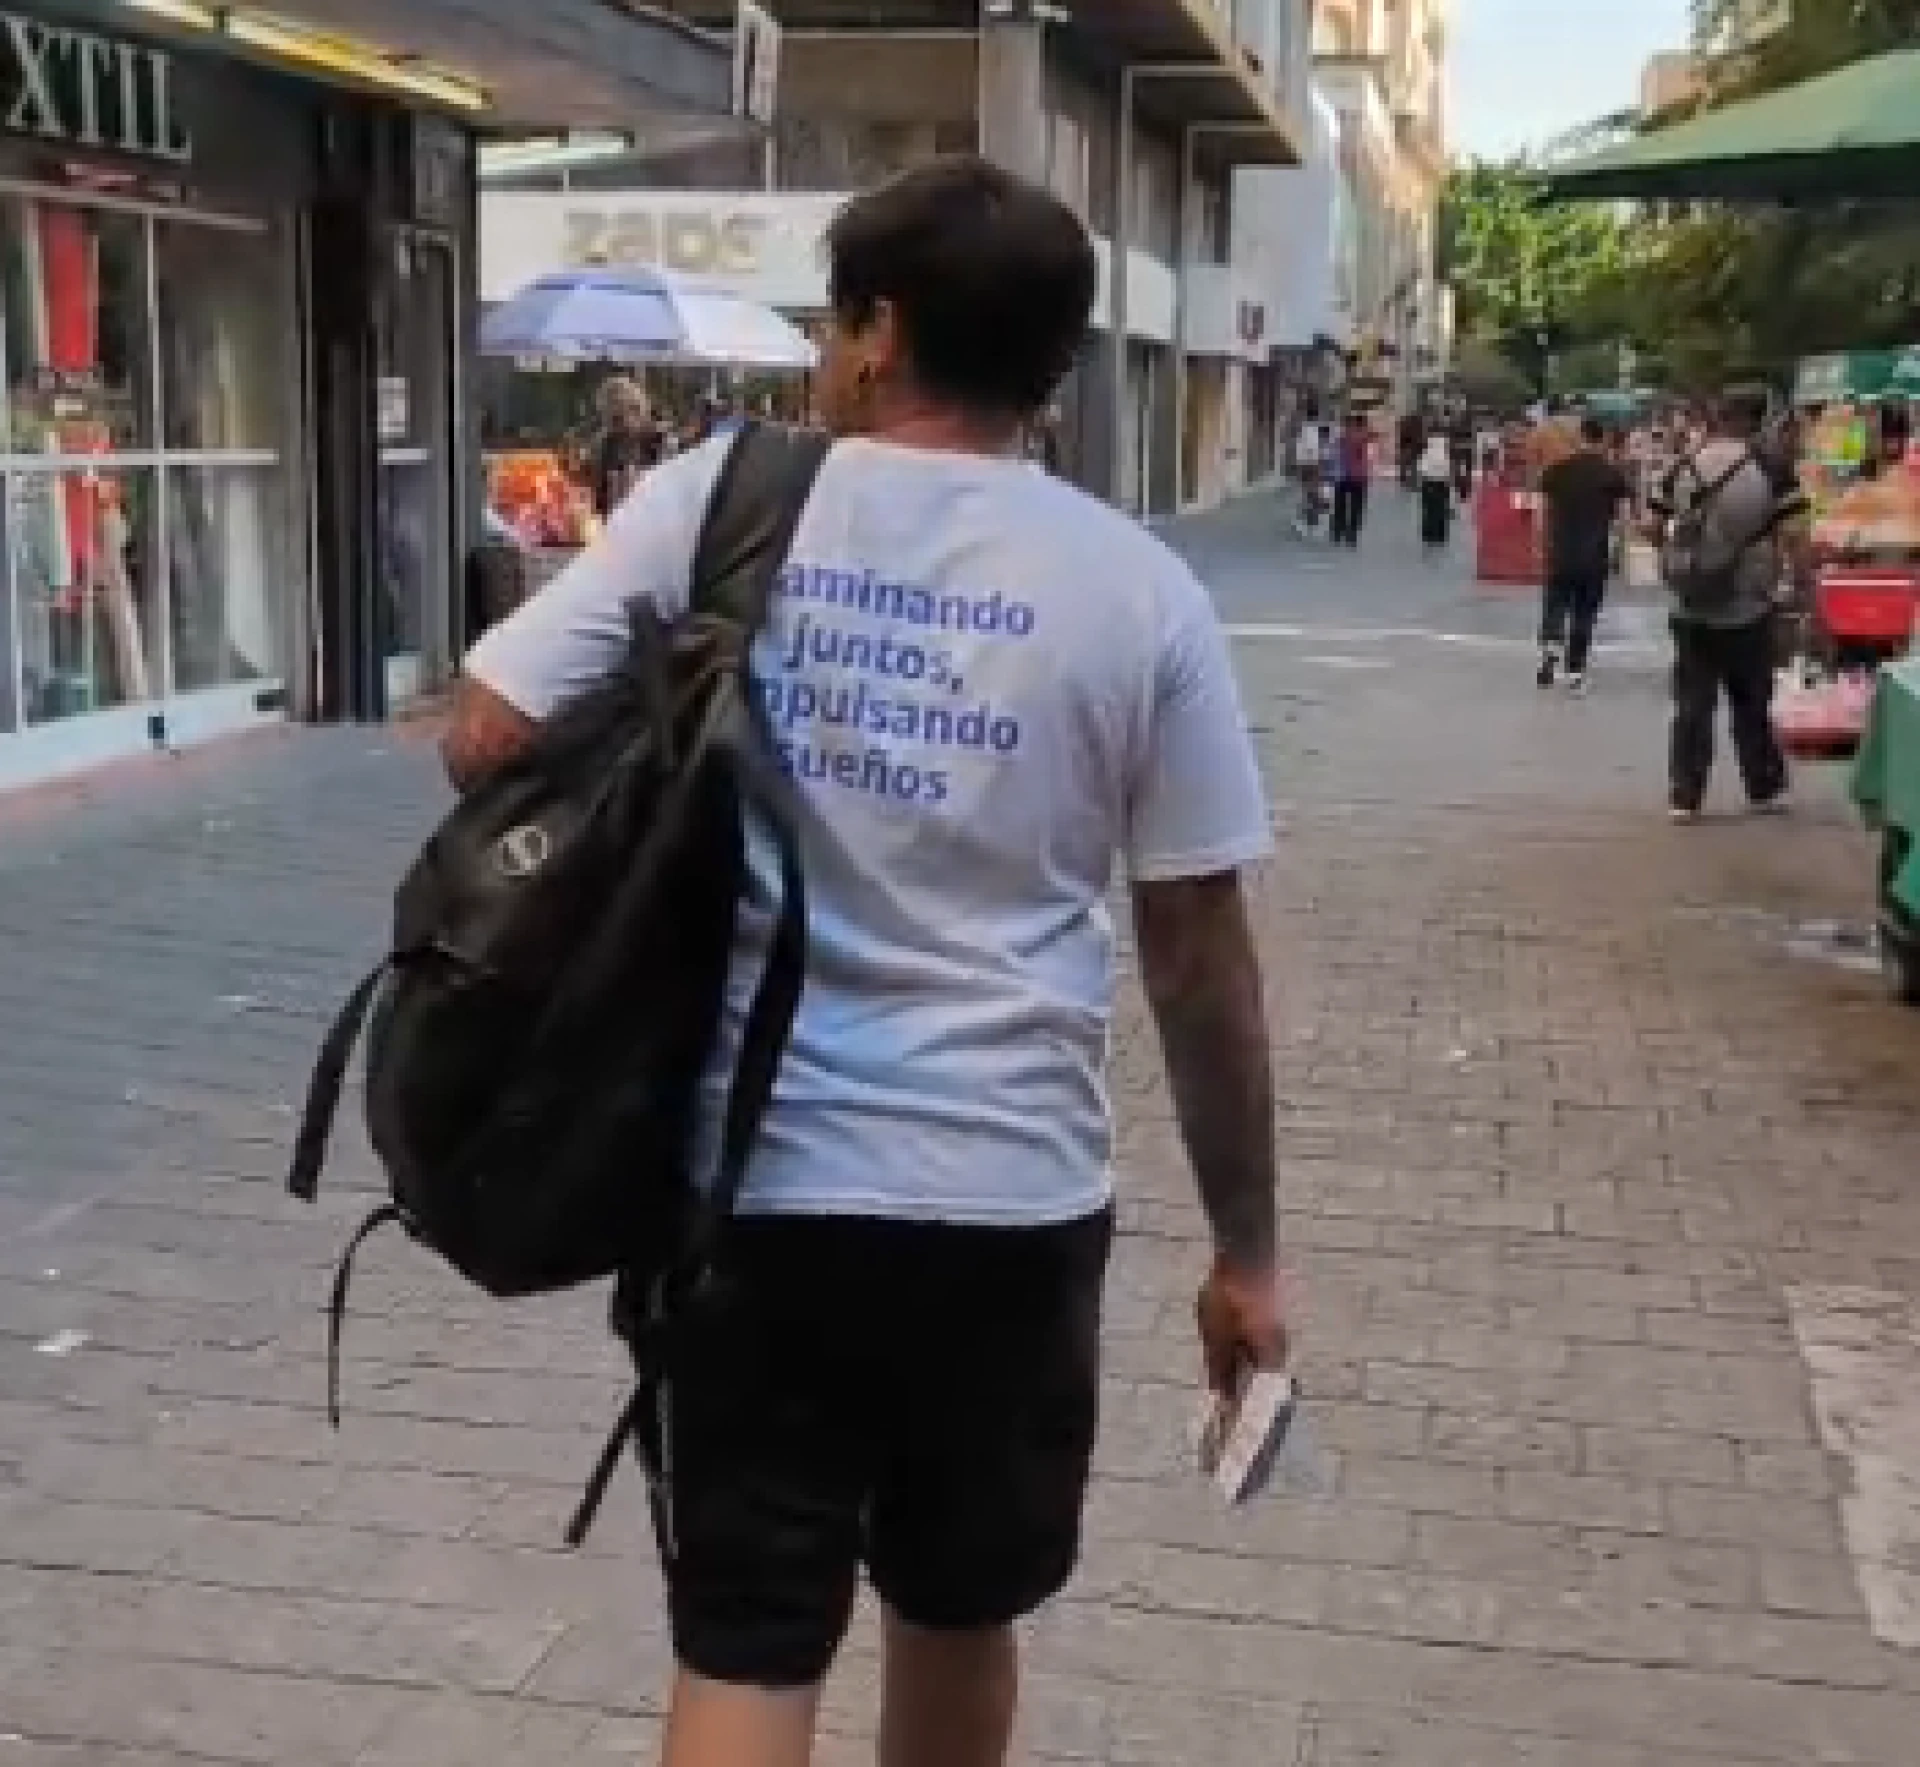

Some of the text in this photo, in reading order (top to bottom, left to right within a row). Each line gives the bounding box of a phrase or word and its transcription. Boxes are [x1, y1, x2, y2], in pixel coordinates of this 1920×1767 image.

[3, 15, 193, 164] XTIL
[778, 562, 1035, 636] aminando
[763, 678, 1019, 751] pulsando
